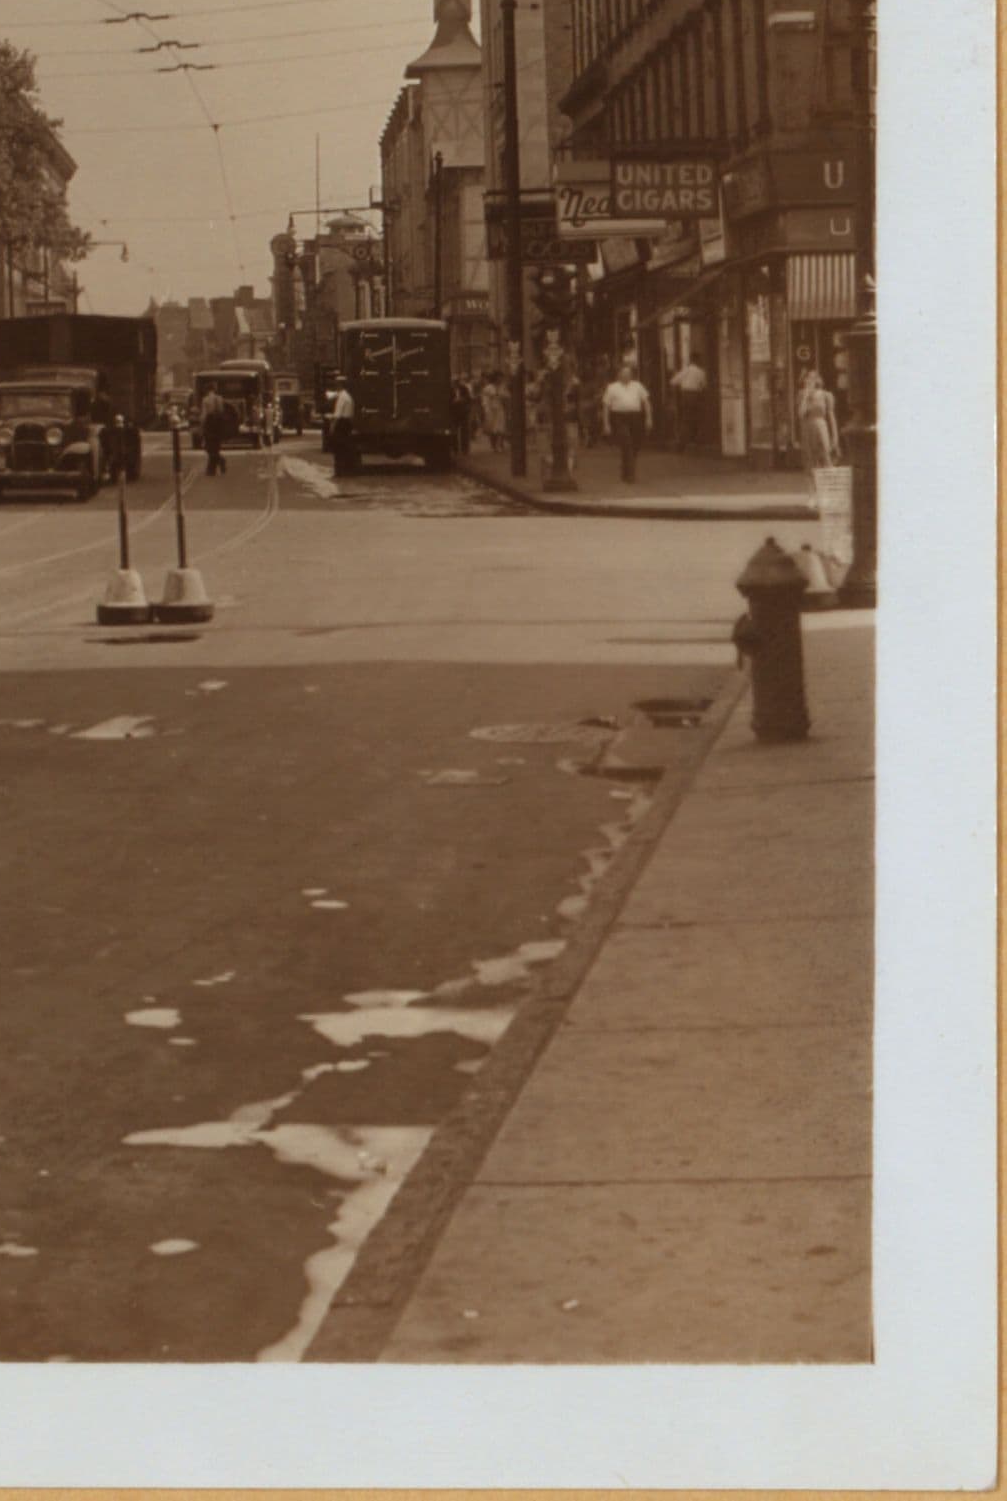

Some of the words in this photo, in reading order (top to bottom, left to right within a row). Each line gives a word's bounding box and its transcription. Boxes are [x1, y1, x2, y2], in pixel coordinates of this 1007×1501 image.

[617, 163, 712, 186] UNITED
[822, 160, 844, 189] U
[617, 188, 712, 212] CIGARS
